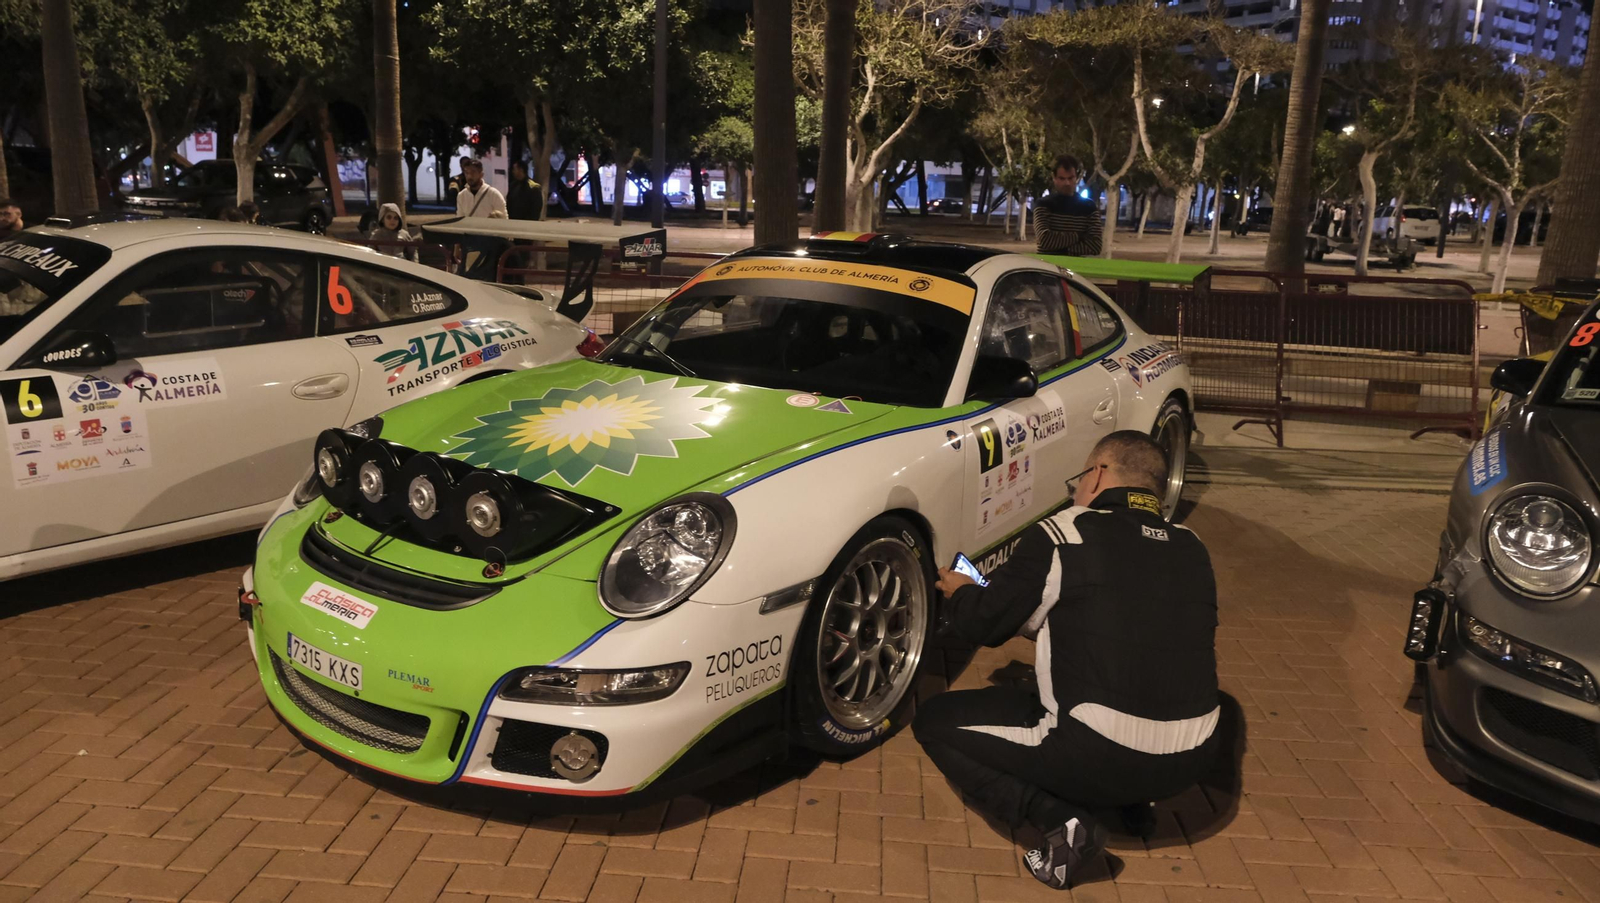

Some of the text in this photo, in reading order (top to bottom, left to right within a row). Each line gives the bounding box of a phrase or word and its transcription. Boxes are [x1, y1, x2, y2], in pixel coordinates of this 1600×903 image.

[3, 243, 79, 278] CHIPEAUX
[737, 264, 900, 285] AUTOMÓVIL CLUB DE ALMERÍA
[327, 265, 353, 315] 6
[412, 301, 446, 314] O.Roman
[408, 320, 529, 372] AZNAR
[1568, 322, 1600, 347] 8
[43, 347, 82, 363] LOURDES
[387, 337, 538, 397] TRANSPORTE Y LOGISTICA
[162, 371, 217, 385] COSTA DE
[18, 380, 43, 418] 6
[154, 381, 221, 401] ALMERÍA
[82, 402, 95, 413] 30
[1041, 407, 1064, 424] COSTA DE
[1038, 416, 1065, 440] ALMERÍA
[980, 425, 995, 467] 9
[57, 456, 100, 471] MOYA
[293, 639, 360, 687] 7315 KXS
[706, 634, 783, 677] zapata
[388, 669, 430, 687] PLEMAR
[412, 684, 434, 693] SPORT
[706, 662, 781, 704] PELUQUEROS
[822, 720, 872, 744] MICHELIN
[1027, 849, 1044, 870] OMP
